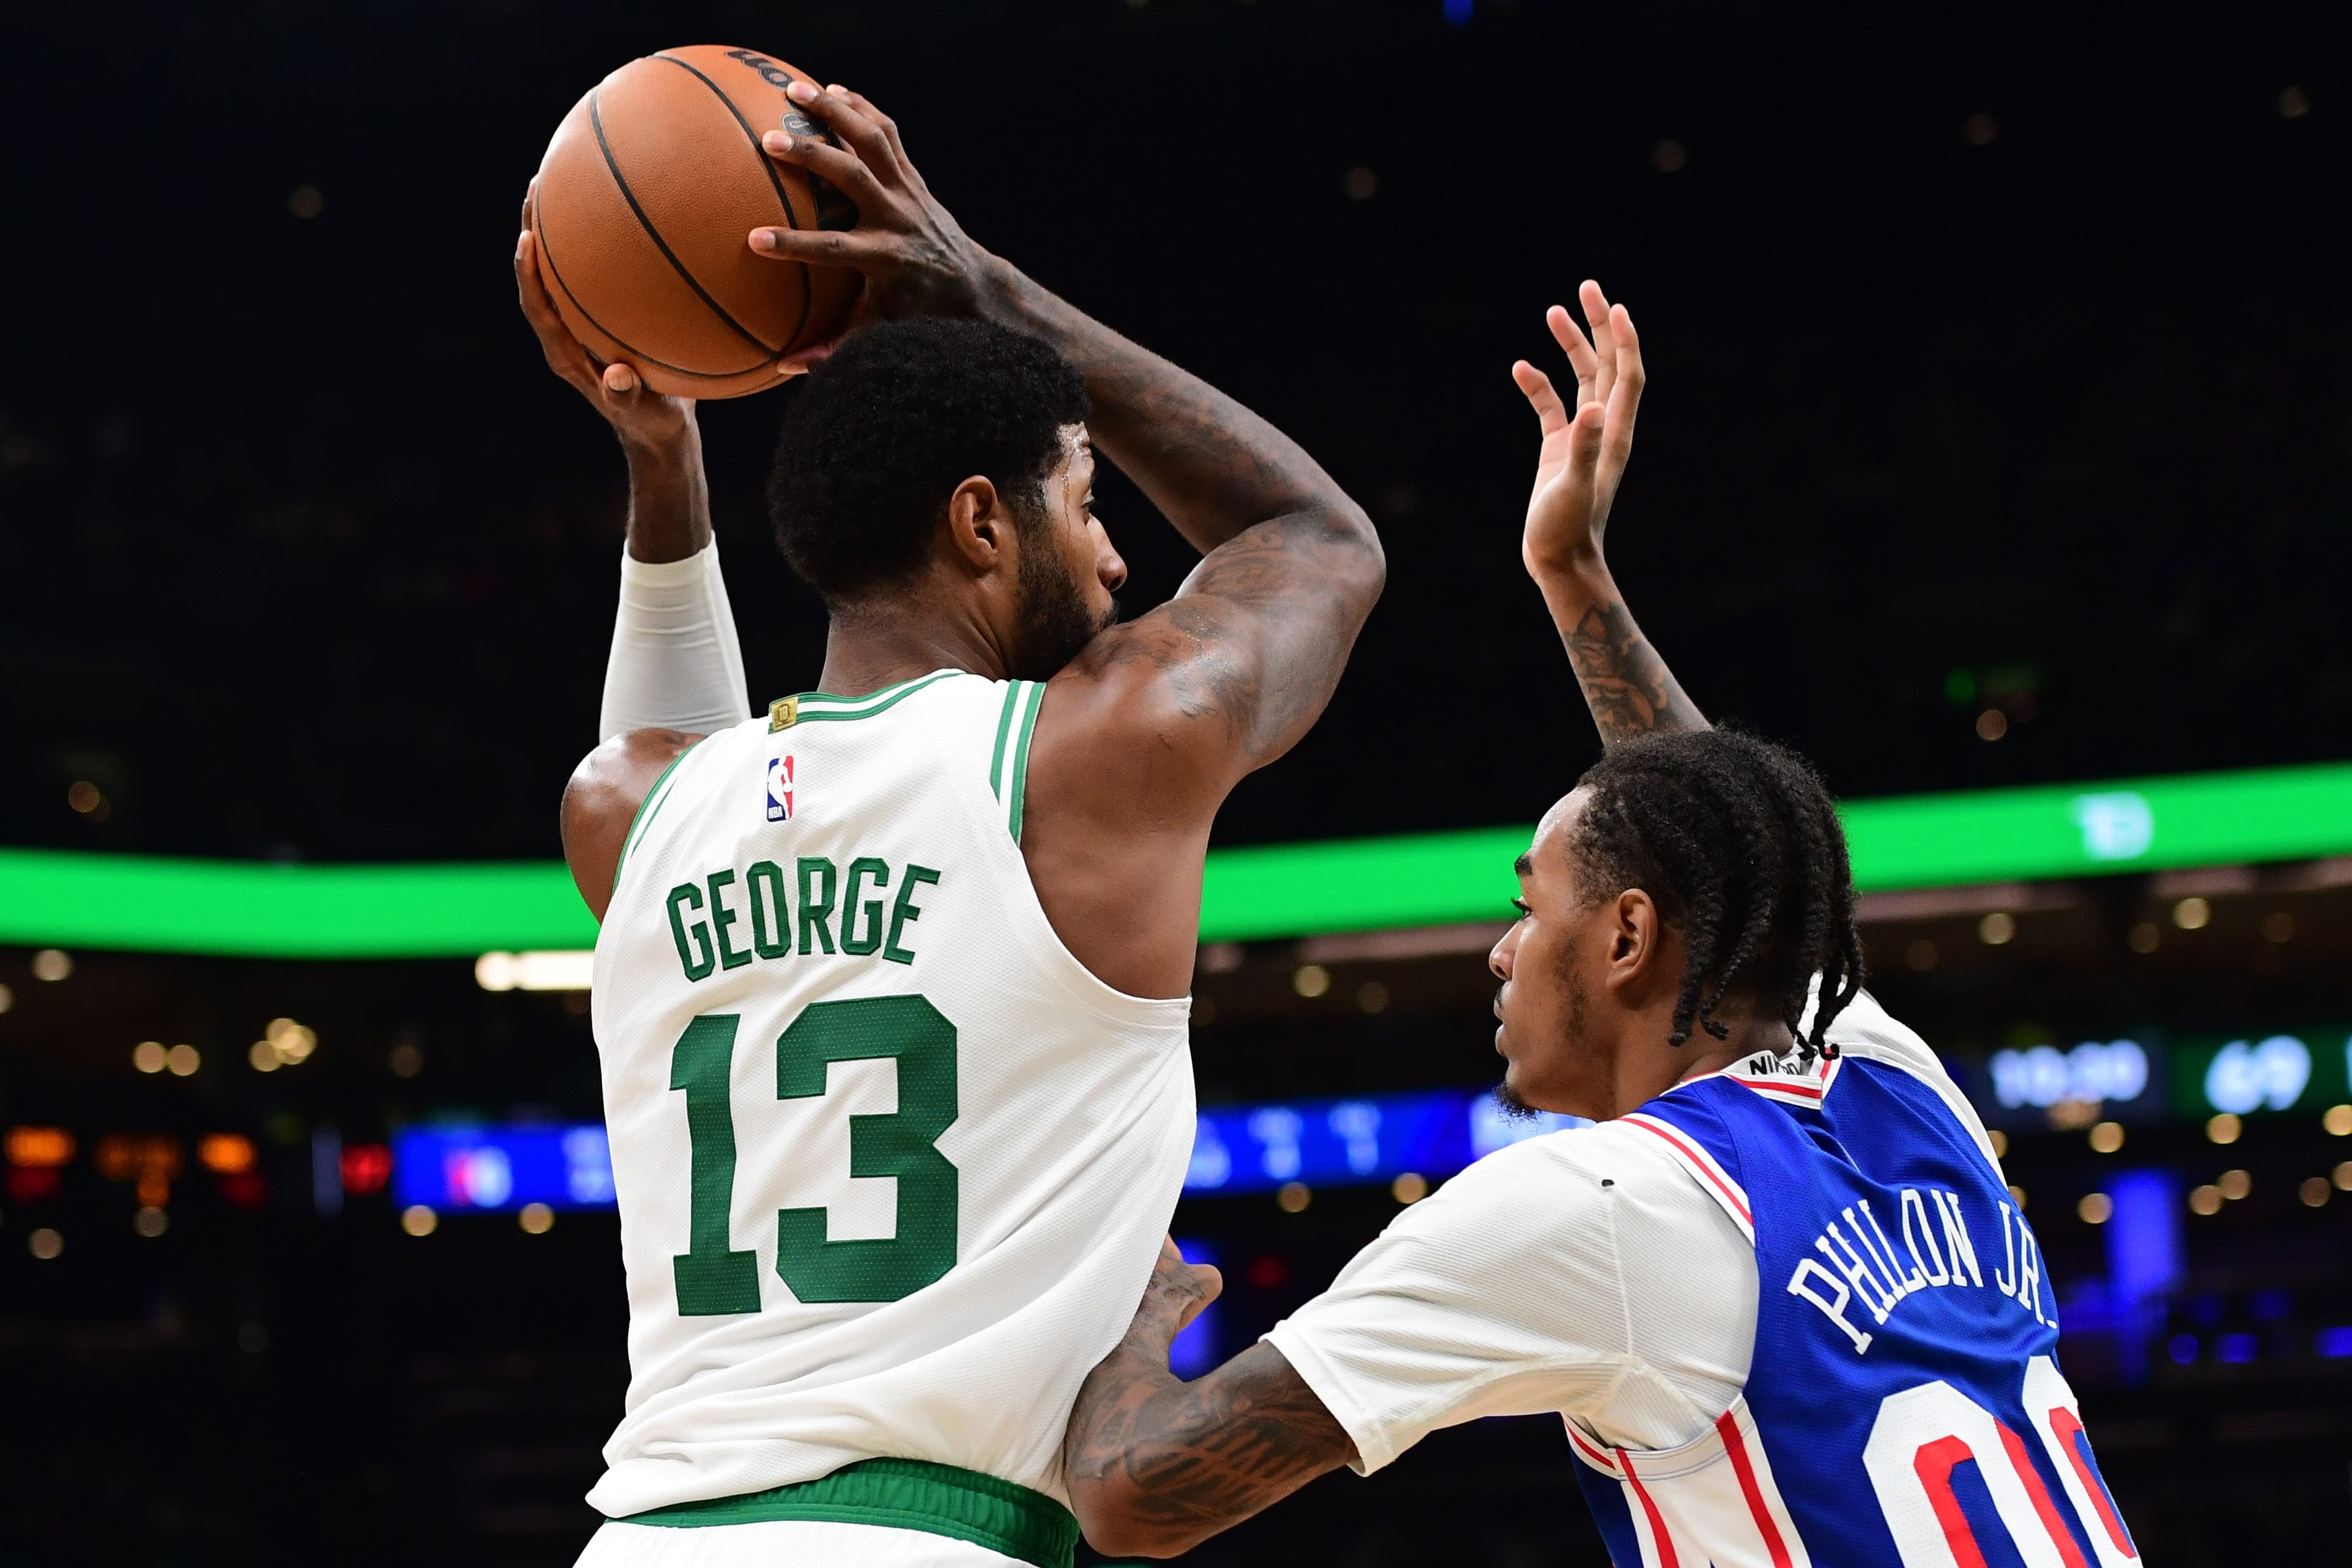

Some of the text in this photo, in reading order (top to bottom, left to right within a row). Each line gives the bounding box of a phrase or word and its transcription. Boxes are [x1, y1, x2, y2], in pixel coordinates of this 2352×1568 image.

[769, 805, 783, 819] NBA
[665, 857, 941, 982] GEORGE
[2205, 1036, 2312, 1114] 69
[669, 993, 959, 1316] 13
[1787, 1188, 2057, 1355] PHILON JR.
